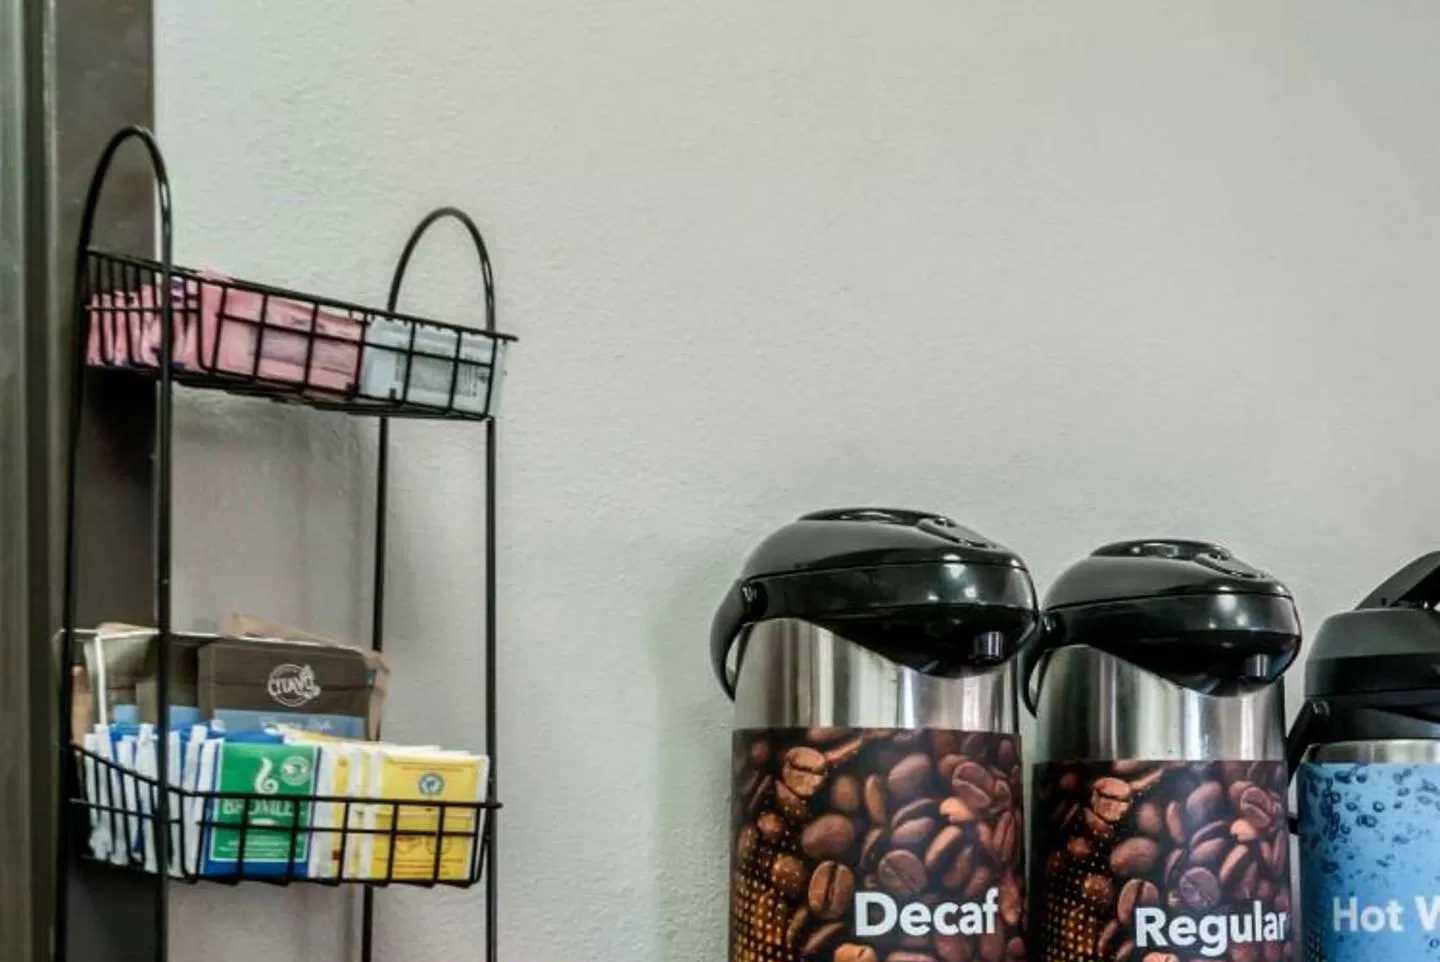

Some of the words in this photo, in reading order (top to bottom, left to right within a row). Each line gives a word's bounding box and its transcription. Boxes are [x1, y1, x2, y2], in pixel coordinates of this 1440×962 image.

[854, 886, 1000, 937] Decaf
[1135, 899, 1287, 958] Regular
[1332, 896, 1405, 933] Hot
